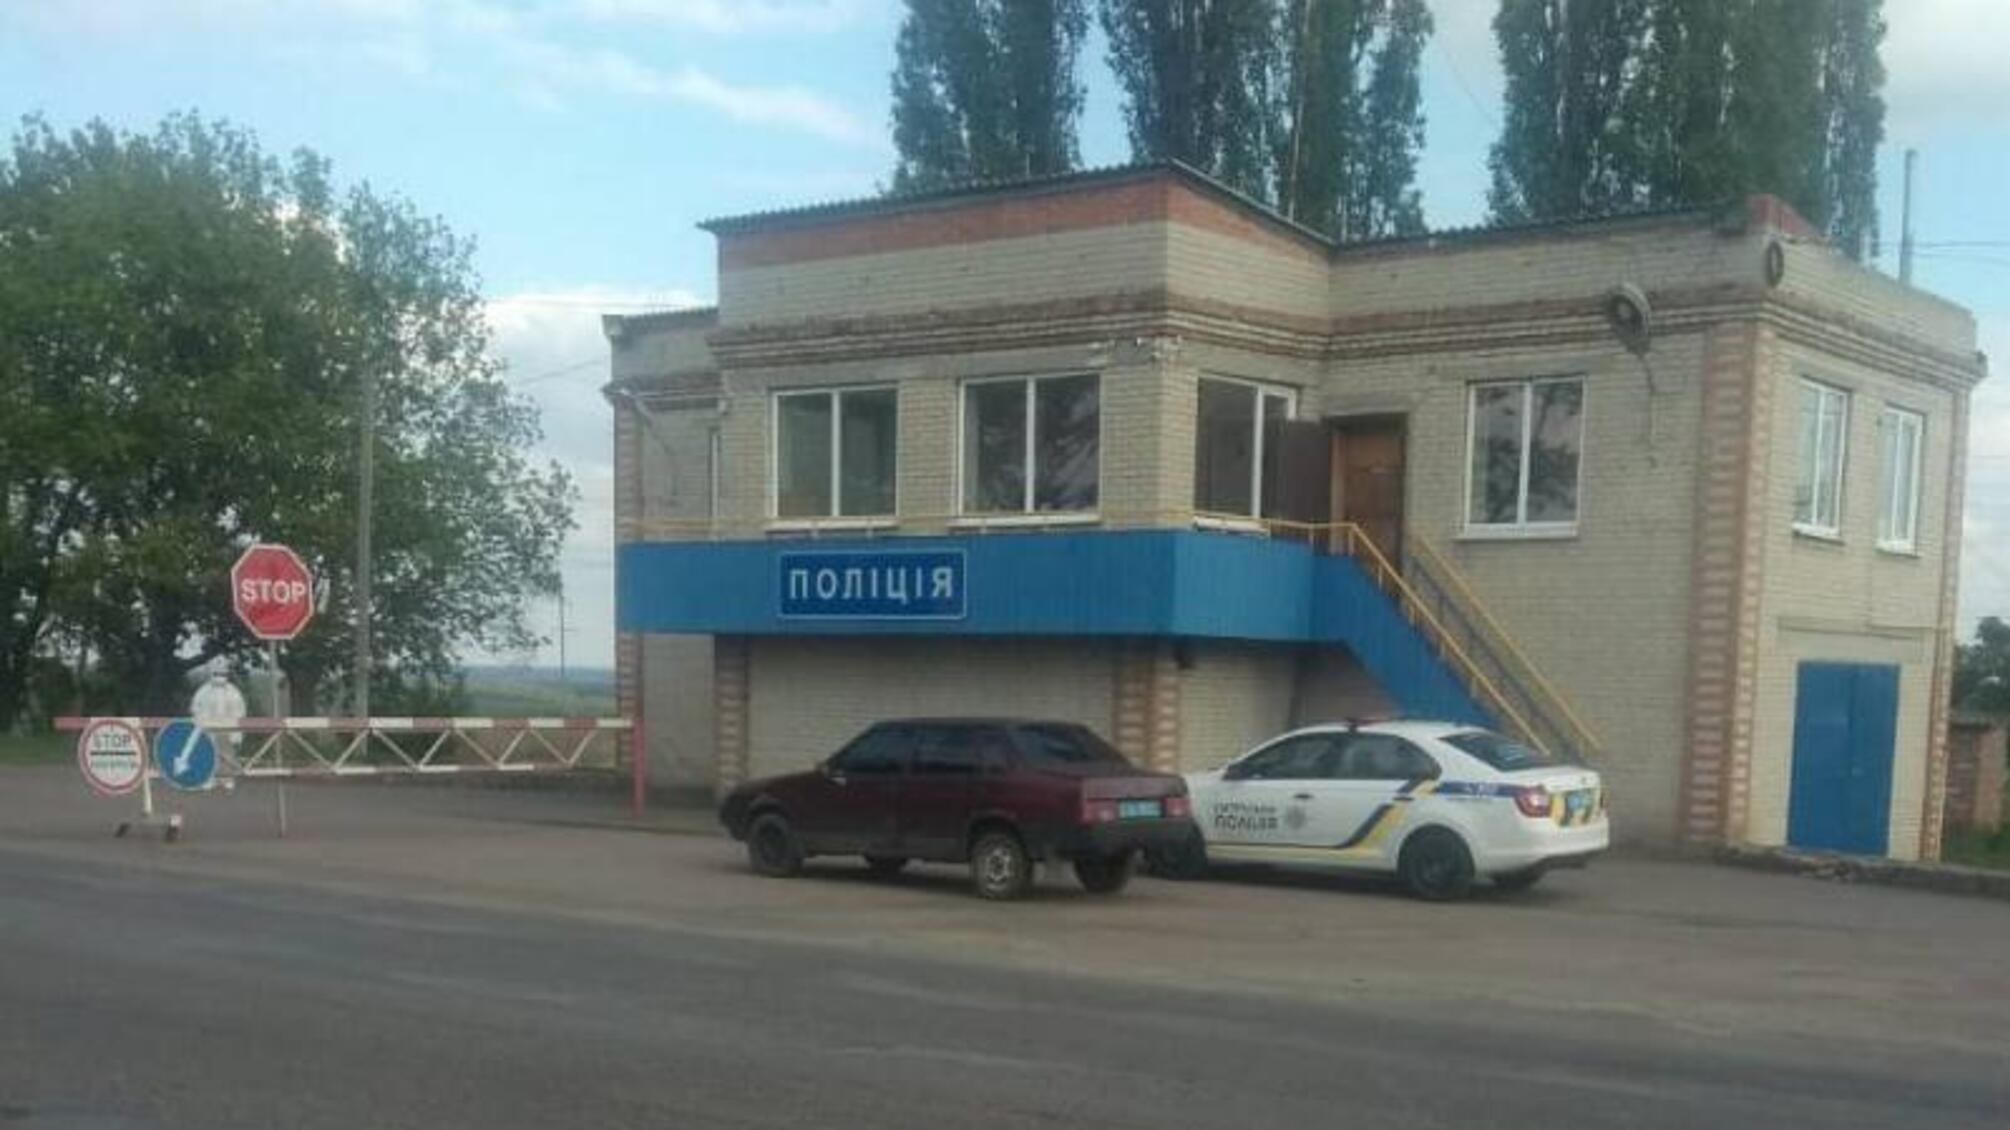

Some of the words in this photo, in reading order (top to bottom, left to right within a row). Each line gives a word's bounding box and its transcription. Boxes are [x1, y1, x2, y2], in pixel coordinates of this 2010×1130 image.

[241, 579, 305, 604] STOP
[790, 567, 953, 605] ПОЛІЦІЯ
[93, 734, 132, 748] STOP
